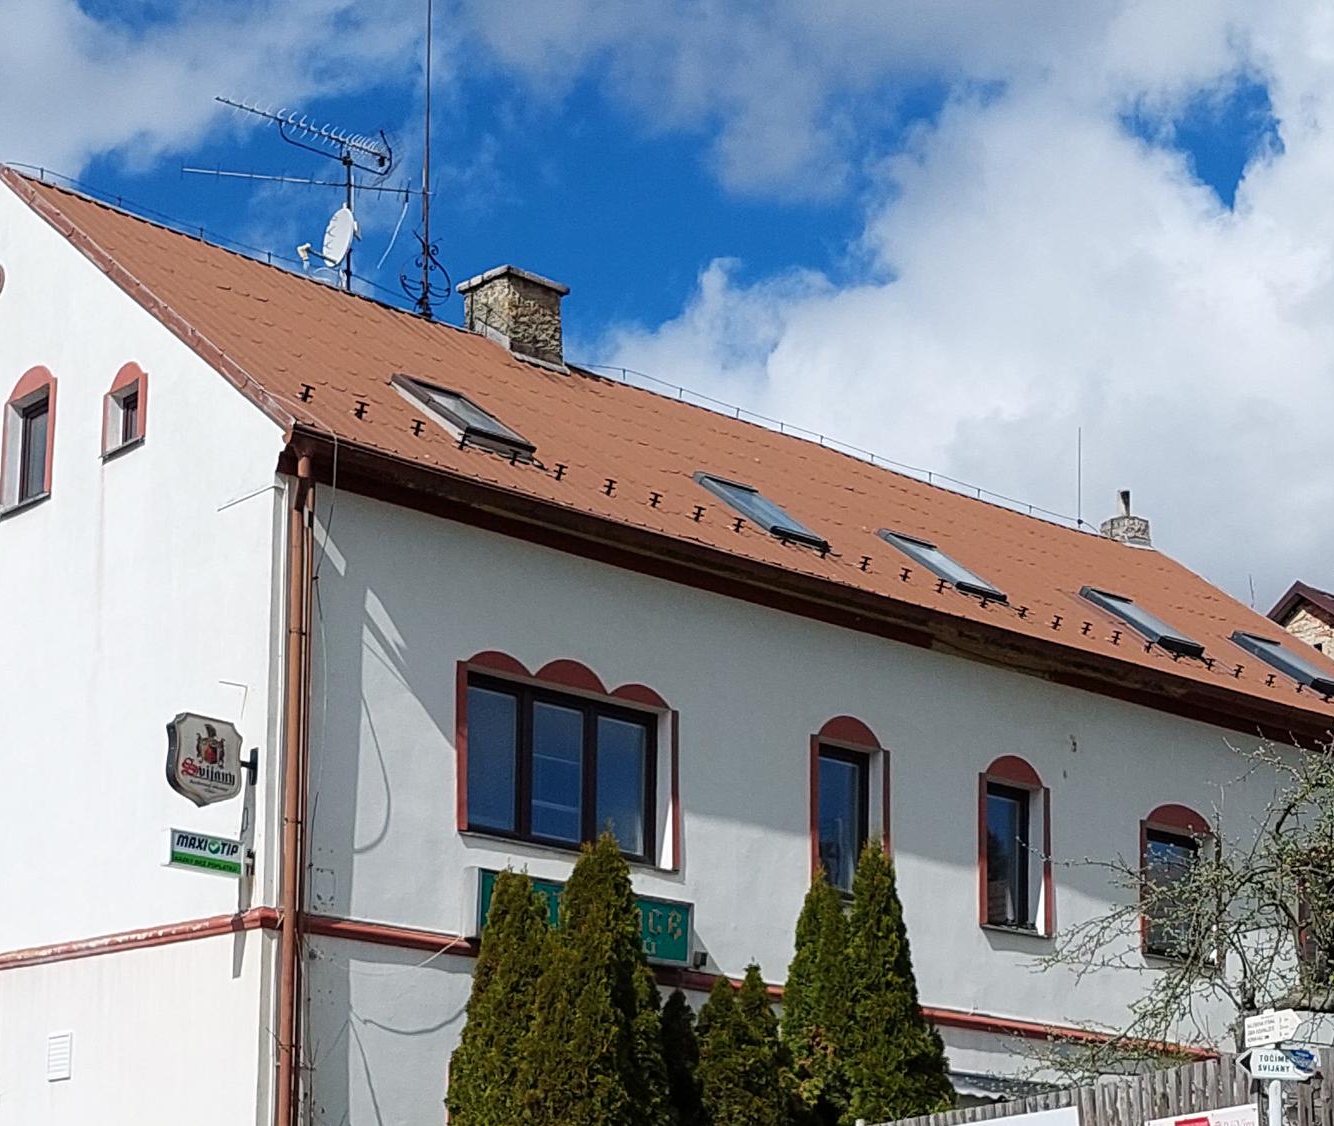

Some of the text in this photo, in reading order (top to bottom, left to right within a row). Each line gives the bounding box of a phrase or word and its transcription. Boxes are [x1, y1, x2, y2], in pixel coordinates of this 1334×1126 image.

[176, 834, 240, 857] MAXI TIP
[1258, 1063, 1291, 1073] SVIJANY
